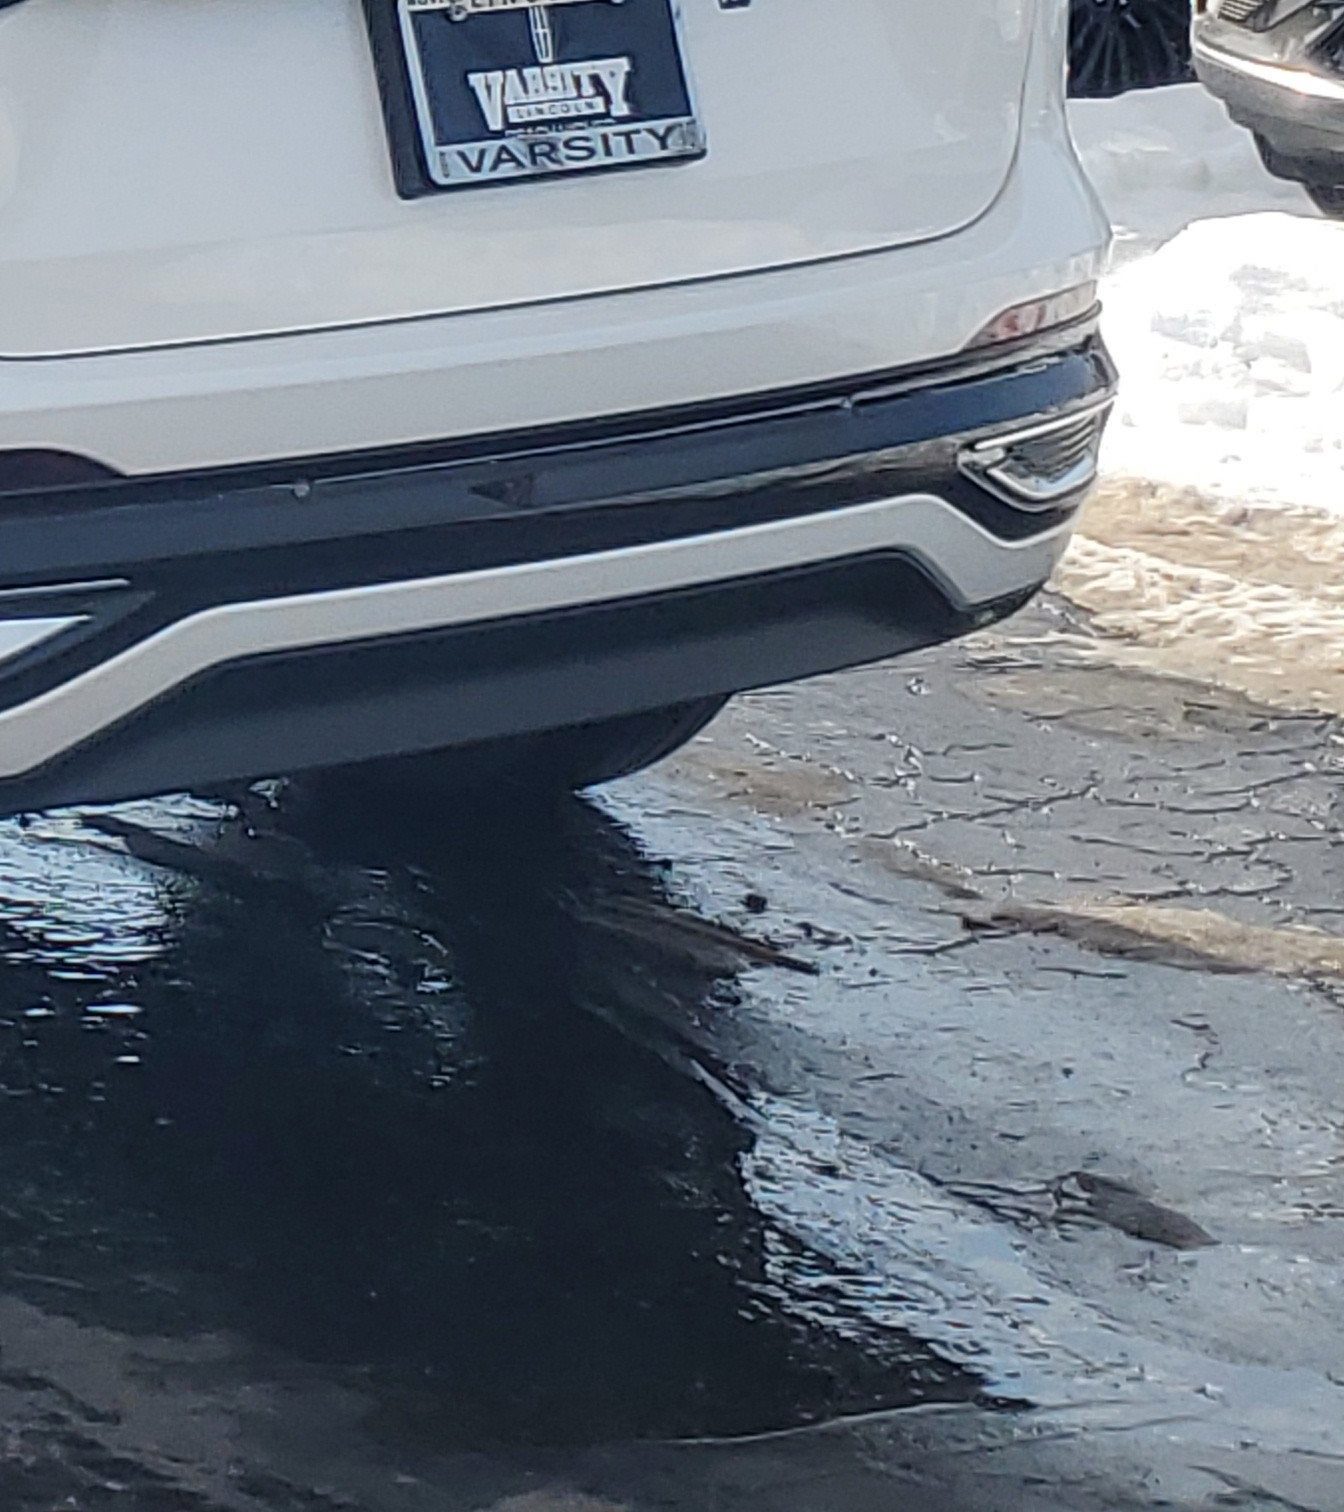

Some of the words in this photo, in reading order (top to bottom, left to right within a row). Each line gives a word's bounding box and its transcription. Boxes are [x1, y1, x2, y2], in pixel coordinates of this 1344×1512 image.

[467, 57, 631, 131] VARSITY
[515, 100, 596, 119] LINCOLN
[457, 127, 677, 175] VARSITY
